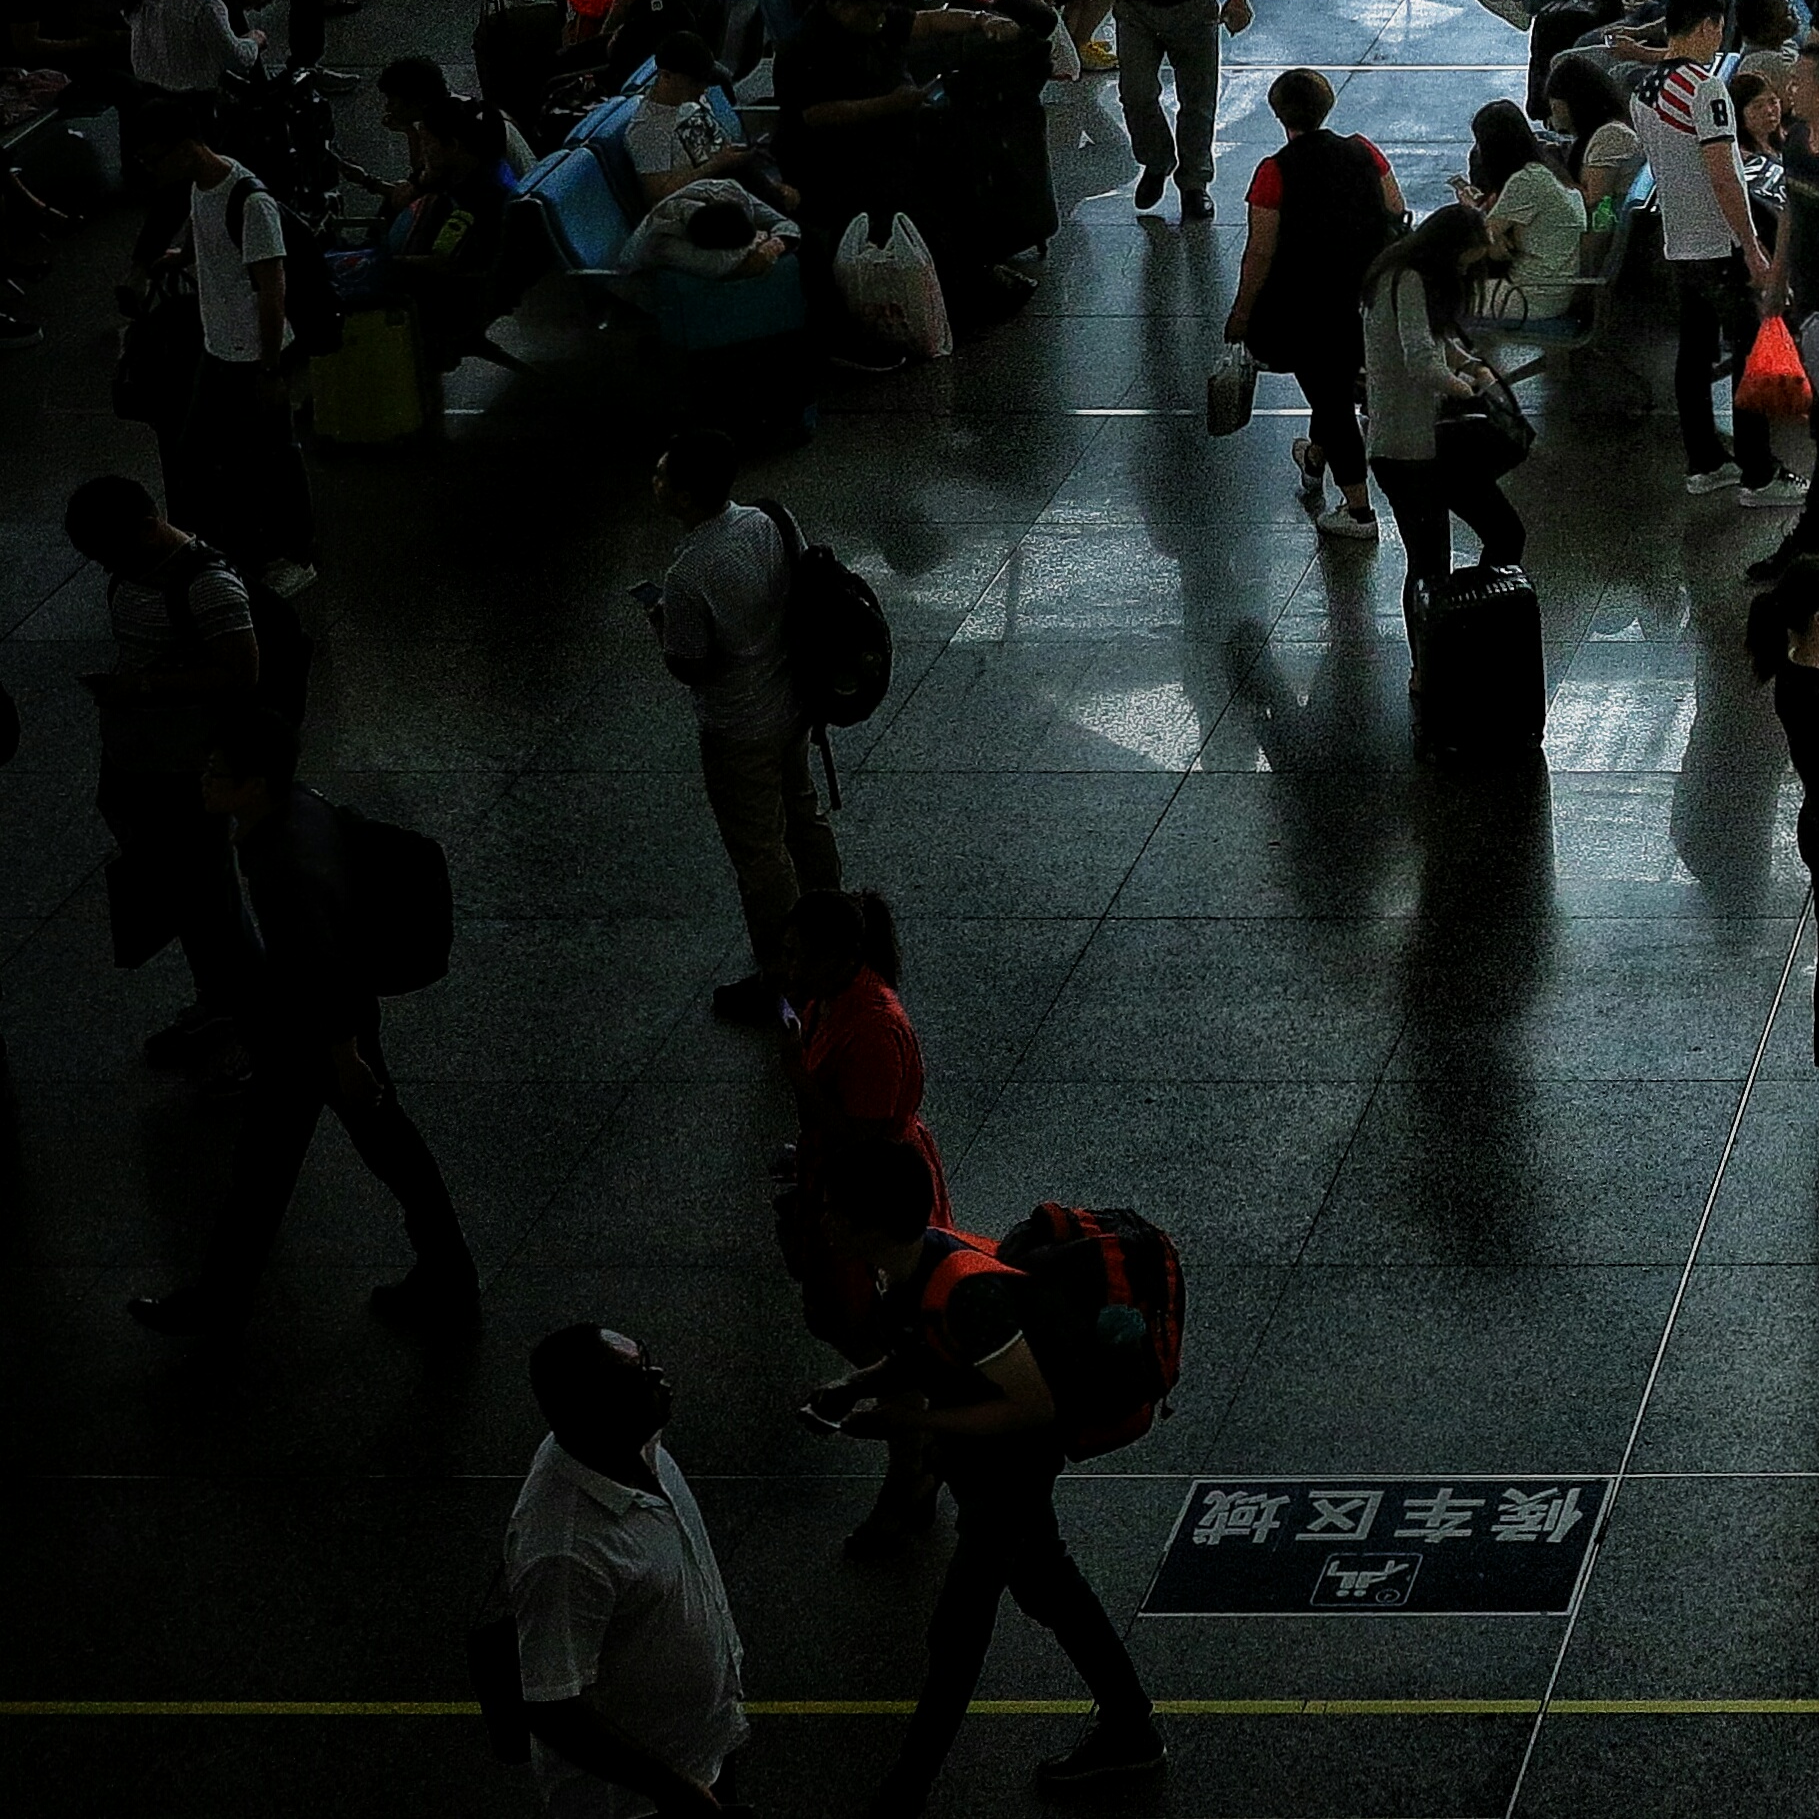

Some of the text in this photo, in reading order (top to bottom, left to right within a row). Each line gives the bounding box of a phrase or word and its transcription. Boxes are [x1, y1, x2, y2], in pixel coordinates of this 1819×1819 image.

[1711, 97, 1728, 127] 8
[1192, 1487, 1584, 1546] 候车区域
